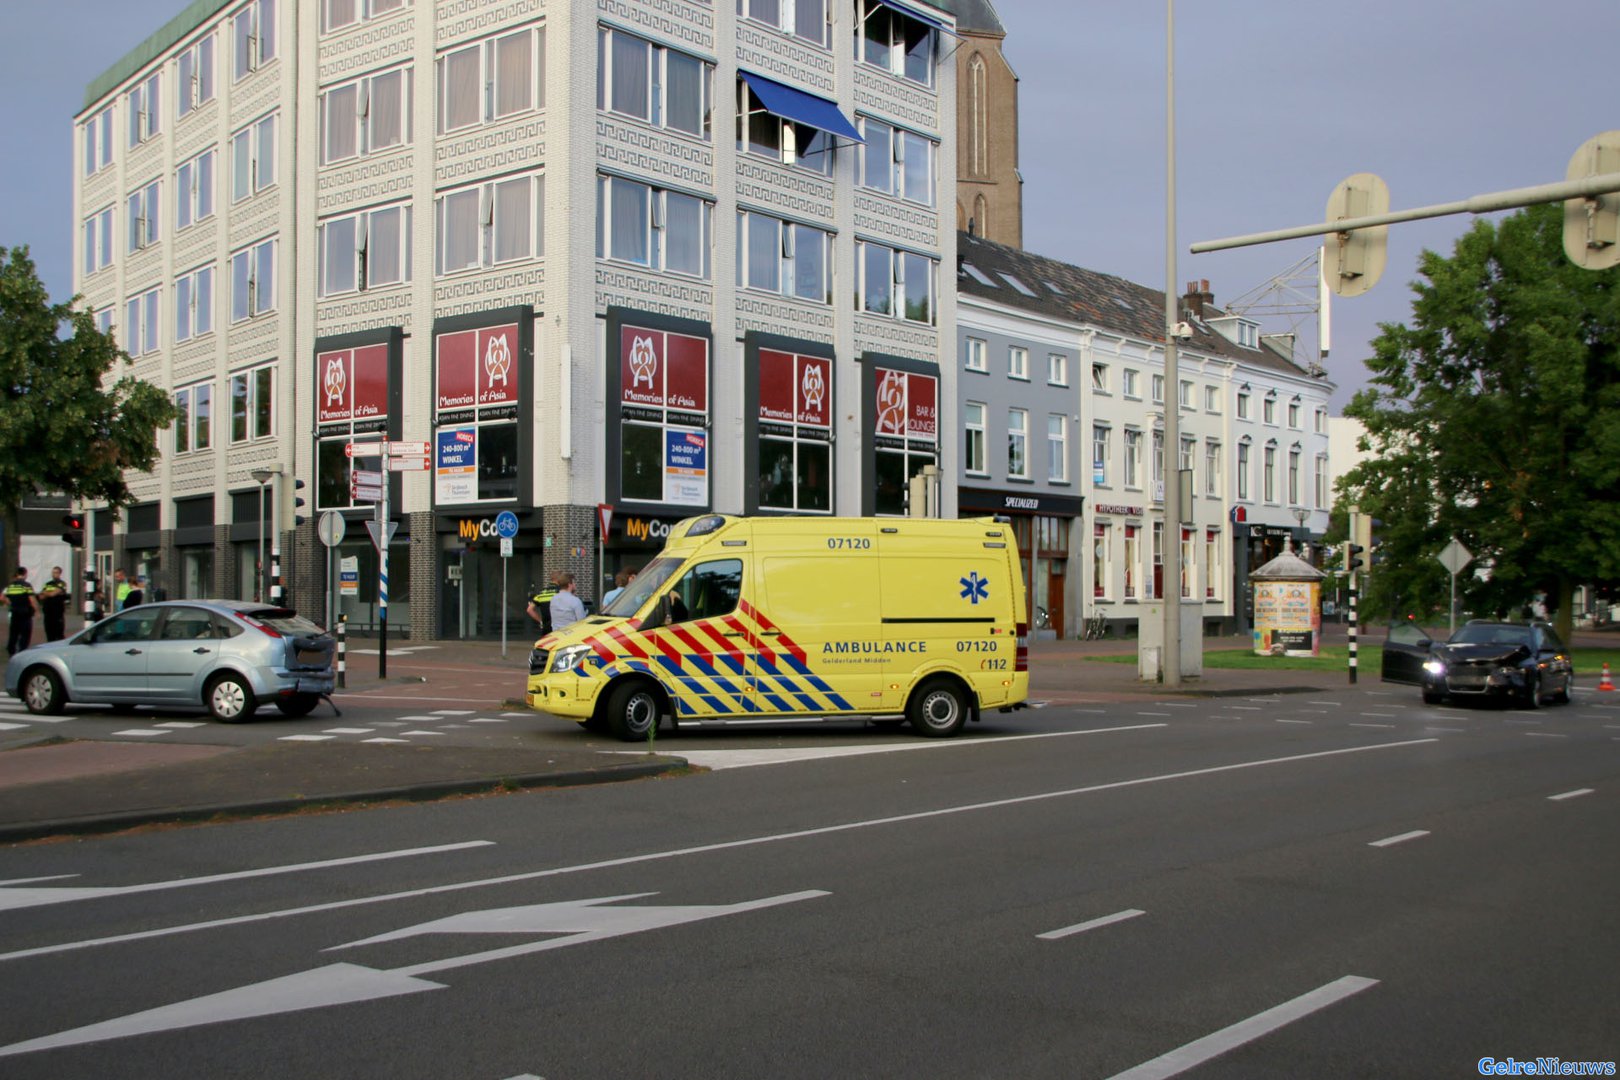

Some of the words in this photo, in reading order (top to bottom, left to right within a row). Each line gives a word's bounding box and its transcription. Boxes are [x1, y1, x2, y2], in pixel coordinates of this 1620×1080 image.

[440, 394, 474, 406] Memories
[480, 391, 488, 402] of
[489, 390, 506, 401] Asia
[625, 389, 662, 404] Memories
[668, 394, 676, 404] of
[678, 396, 696, 406] Asia
[320, 408, 350, 419] Memories
[355, 406, 362, 416] of
[363, 404, 378, 415] Asia
[760, 406, 792, 419] Memories
[798, 412, 805, 421] of
[805, 413, 821, 423] Asia
[916, 405, 928, 417] BAR
[930, 408, 935, 418] &
[443, 455, 463, 464] WINKEL
[671, 455, 693, 465] WINKEL
[1005, 497, 1038, 508] SPECIALIZED
[828, 538, 870, 549] 07120
[823, 641, 926, 653] AMBULANCE
[956, 641, 997, 652] 07120
[988, 659, 1006, 669] 112
